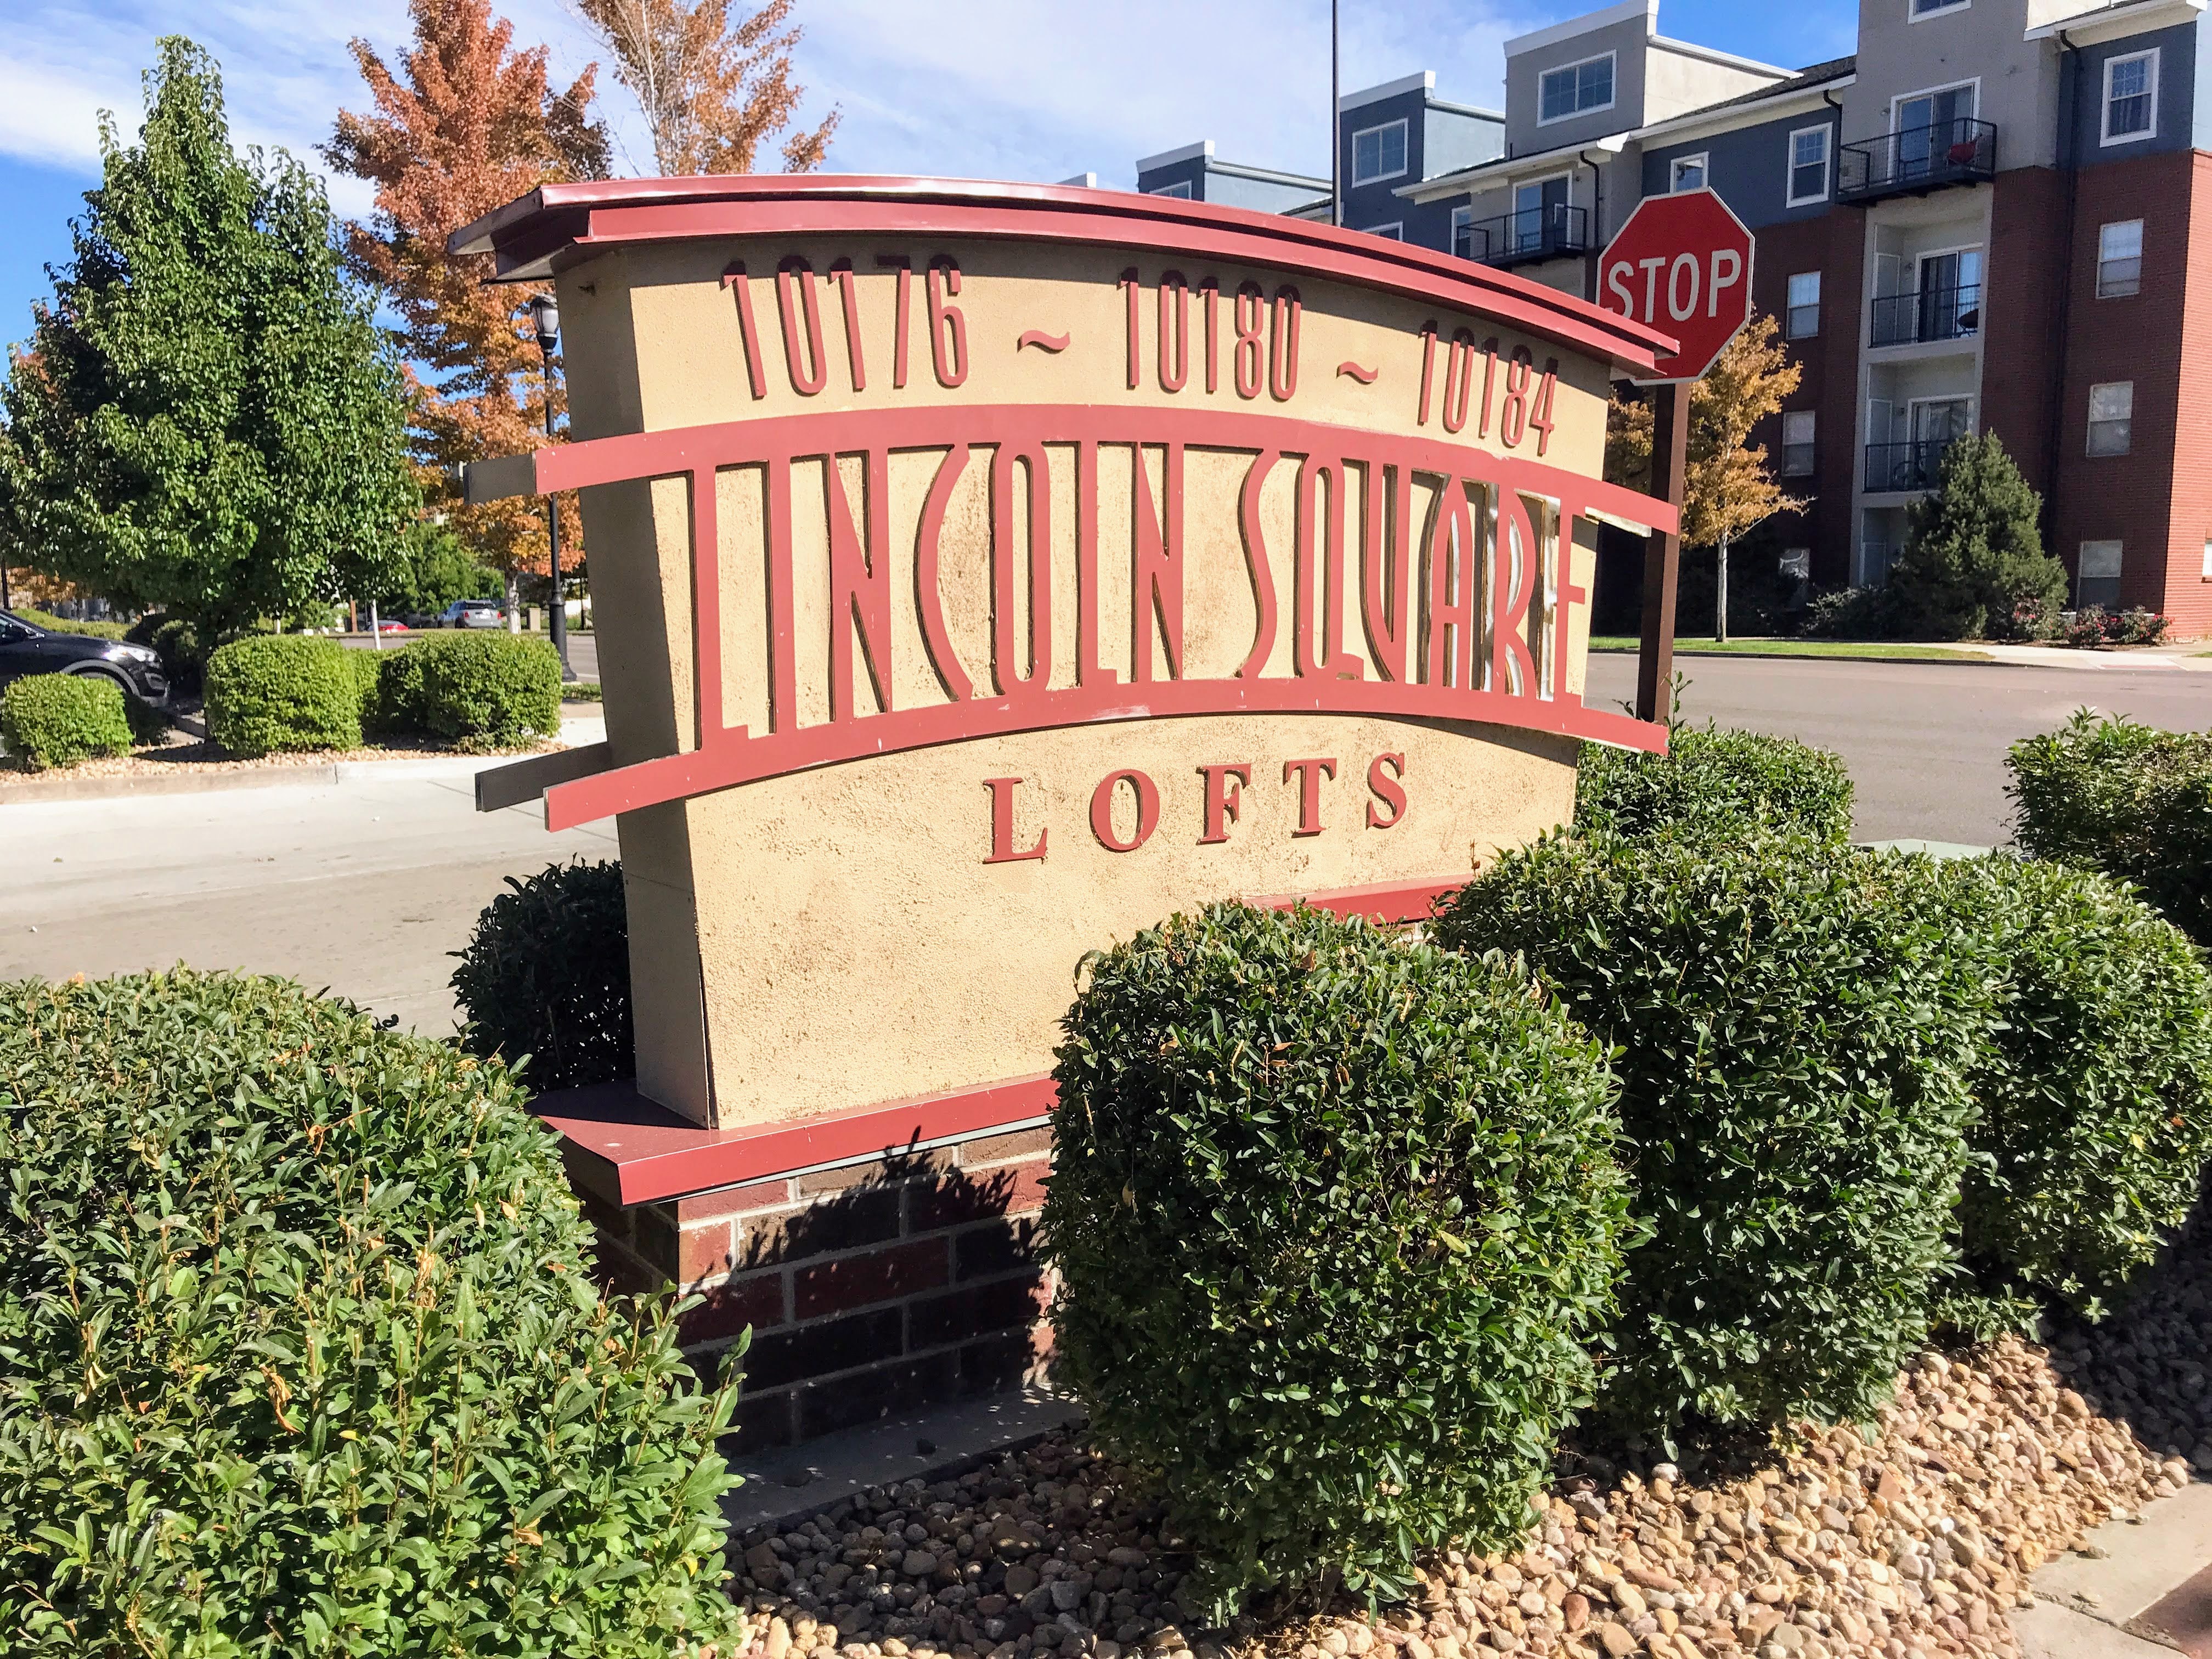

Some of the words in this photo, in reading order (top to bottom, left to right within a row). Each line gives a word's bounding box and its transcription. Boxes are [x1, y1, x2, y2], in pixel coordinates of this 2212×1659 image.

[720, 255, 969, 400] 10176
[1117, 267, 1302, 402] 10180
[1417, 319, 1558, 456] 10184
[1606, 249, 1742, 324] STOP
[690, 439, 1185, 752] LINCOLN
[1239, 450, 1587, 708] SQUARE
[983, 752, 1407, 864] LOFTS
